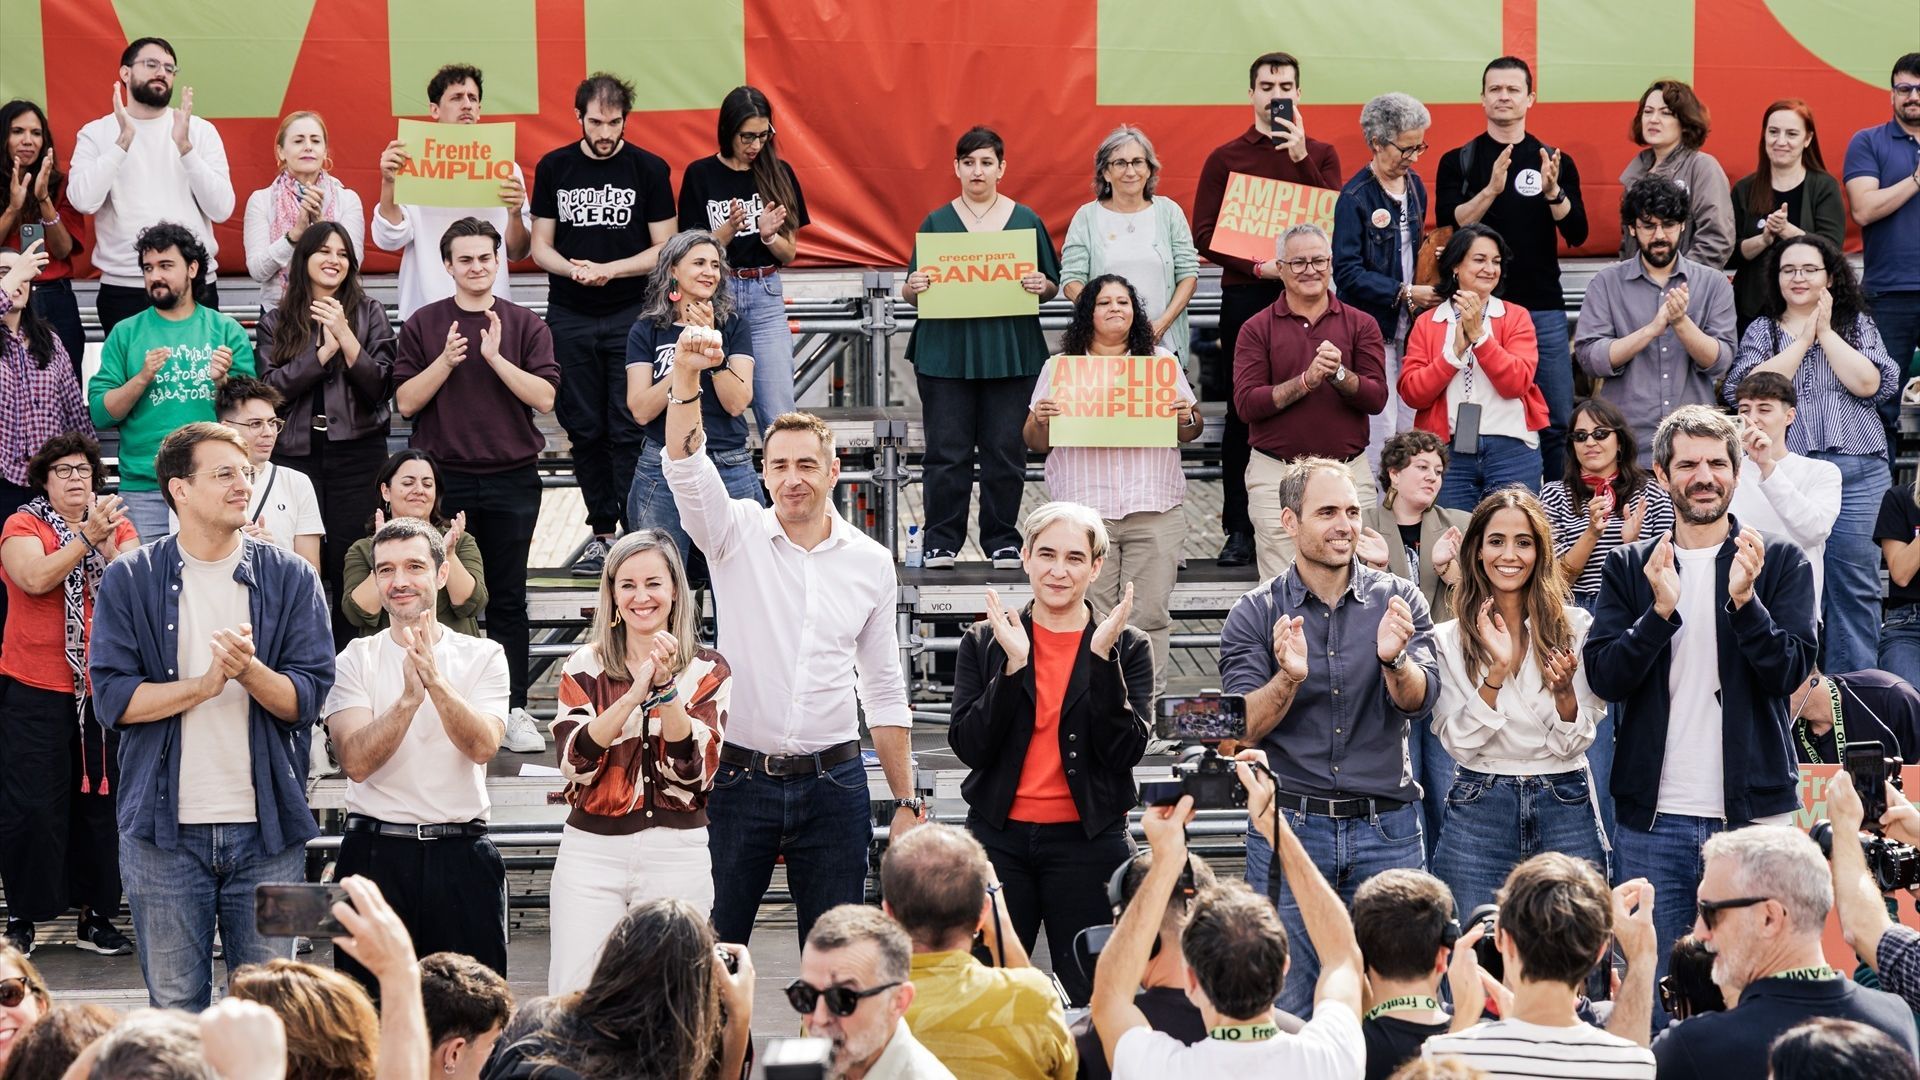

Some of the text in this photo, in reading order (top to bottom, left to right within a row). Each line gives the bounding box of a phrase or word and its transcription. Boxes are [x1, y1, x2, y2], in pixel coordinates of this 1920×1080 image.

[424, 138, 491, 160] Frente
[397, 159, 514, 180] AMPLIO
[557, 184, 636, 222] Recortes
[1226, 174, 1340, 218] AMPLIO
[573, 205, 631, 226] CERO
[706, 193, 764, 233] Reort
[939, 252, 1016, 263] crecer para
[155, 372, 170, 383] DE
[1052, 357, 1177, 387] AMPLIO
[1053, 387, 1177, 402] AMPLIO
[1057, 402, 1176, 418] AMPLIO
[848, 438, 868, 446] VICO
[931, 603, 952, 611] VICO
